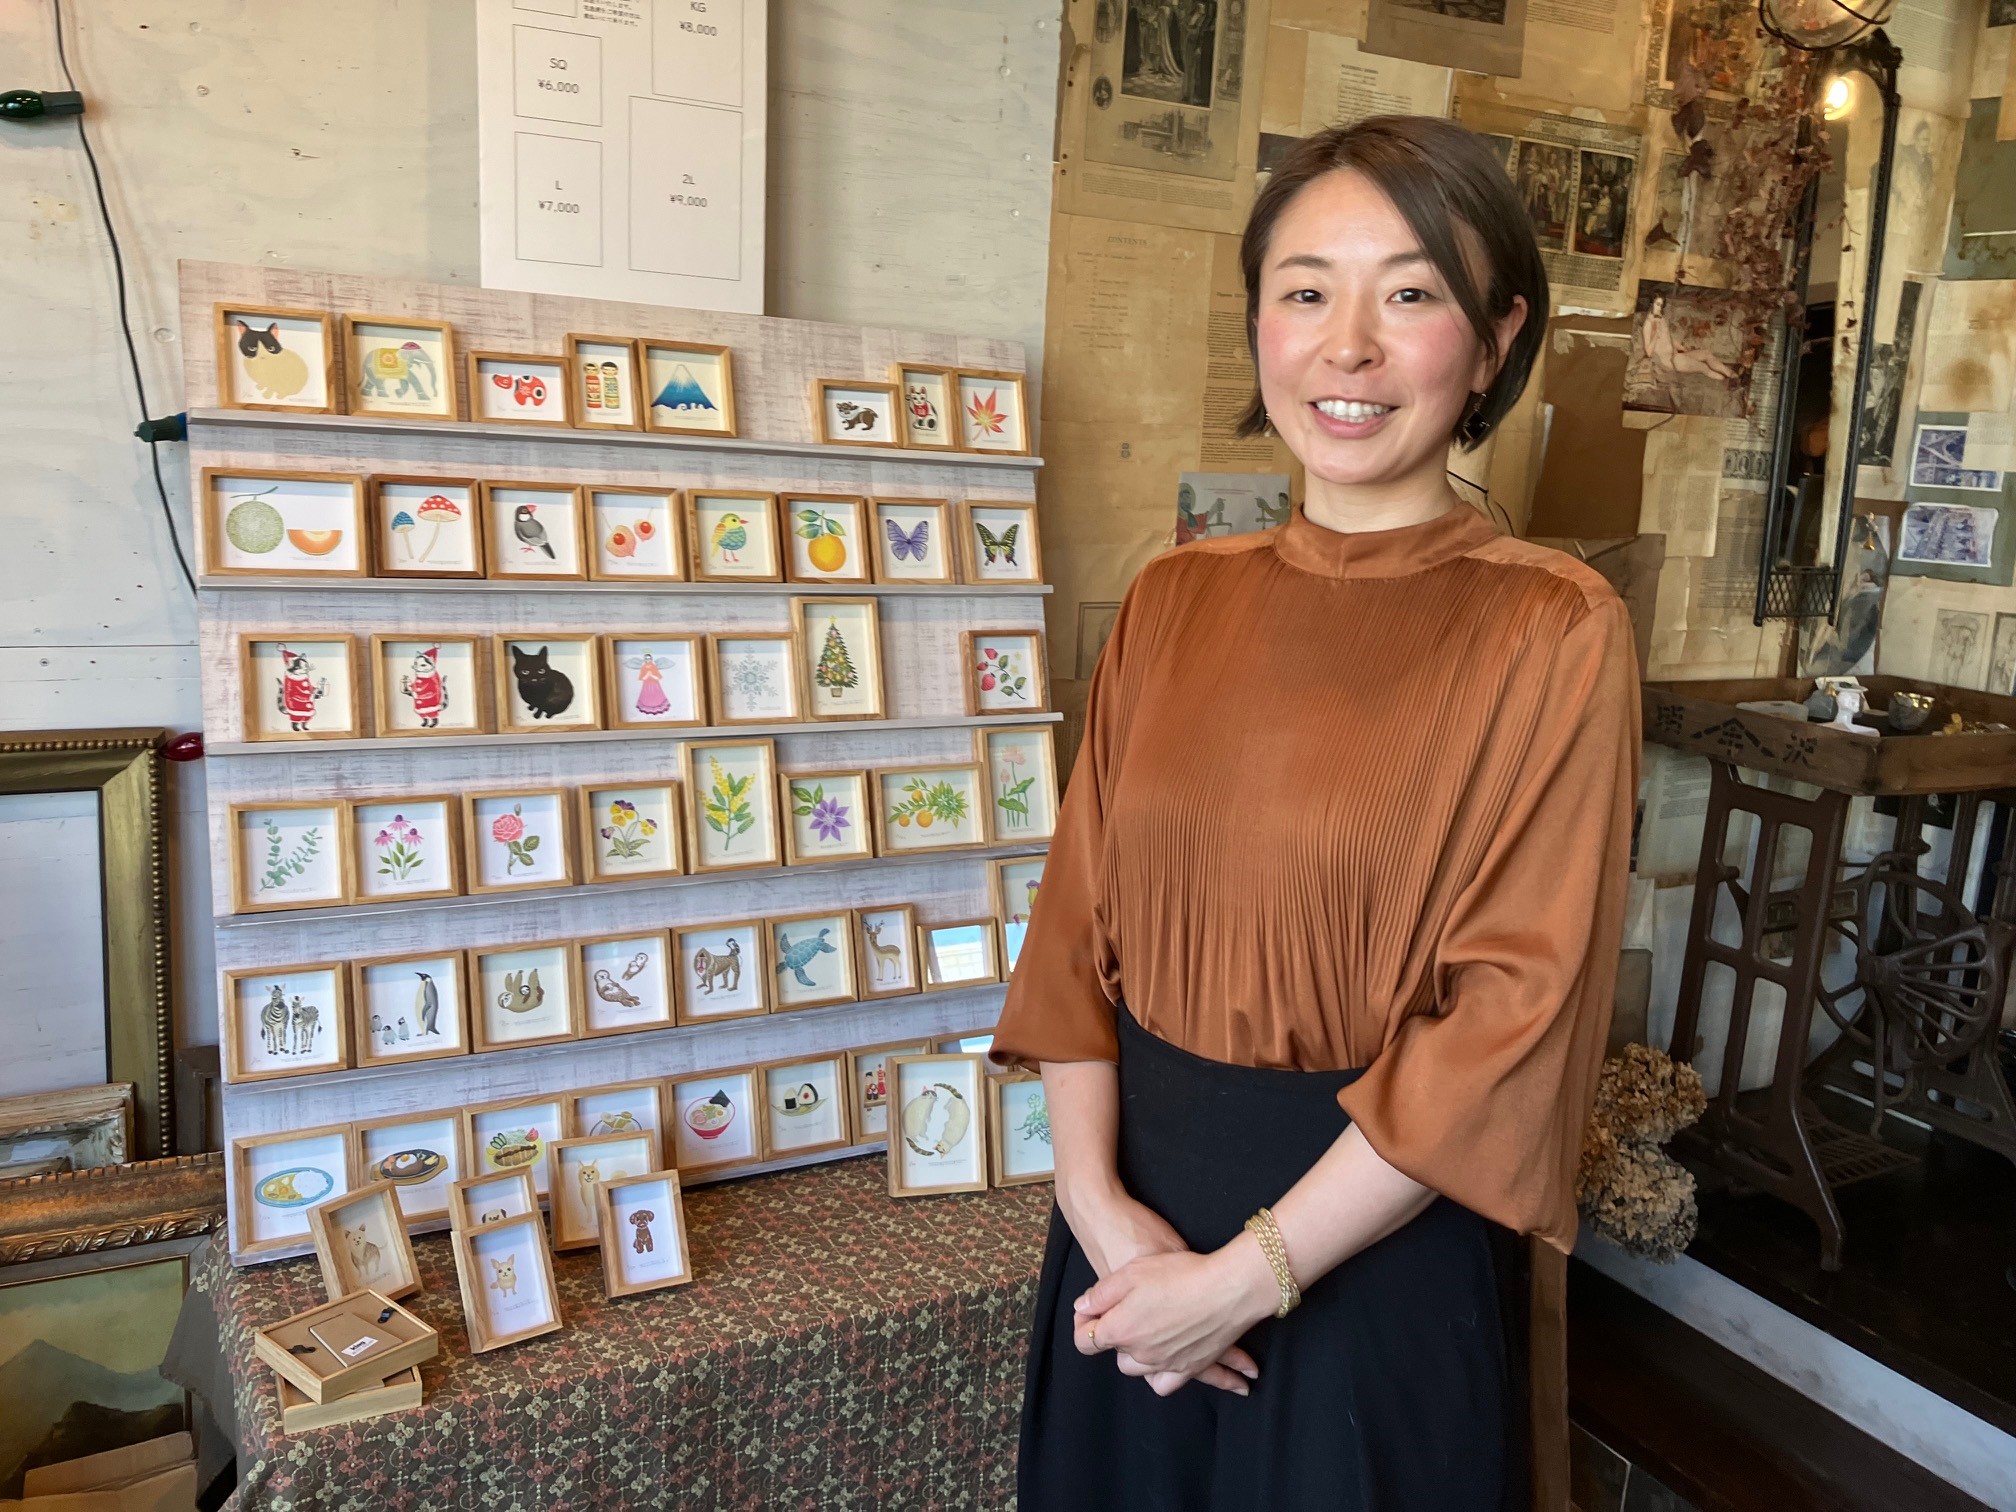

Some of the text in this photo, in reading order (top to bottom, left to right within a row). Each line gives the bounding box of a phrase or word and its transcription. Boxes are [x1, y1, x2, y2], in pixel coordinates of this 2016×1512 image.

[690, 1, 707, 12] KG
[549, 57, 568, 70] SQ
[682, 174, 695, 185] 2L
[555, 180, 563, 191] L
